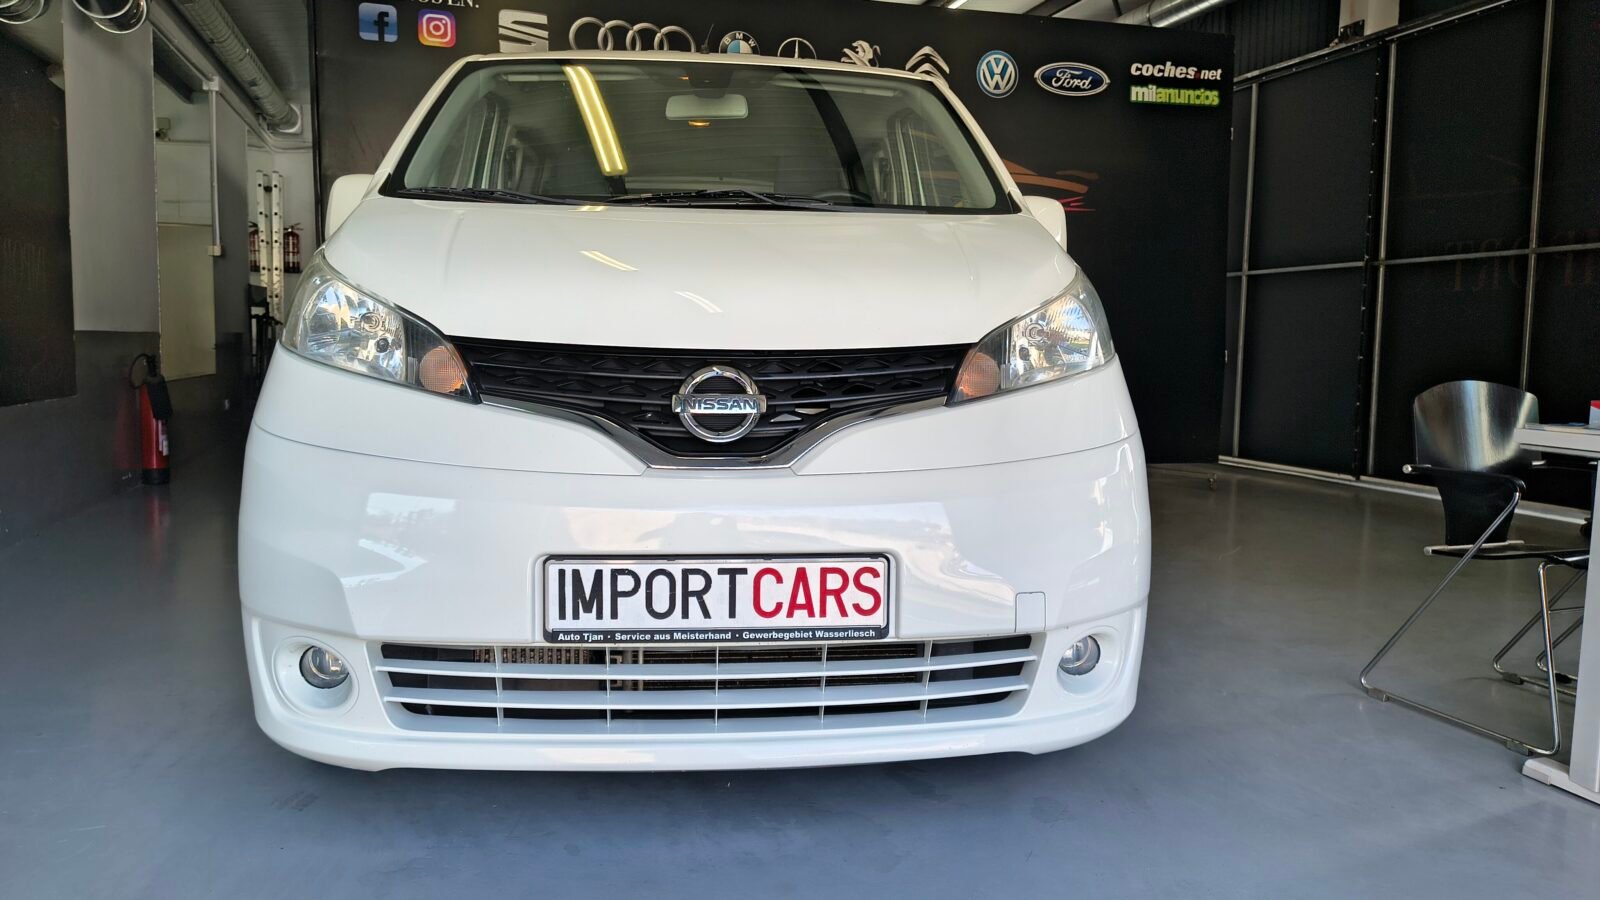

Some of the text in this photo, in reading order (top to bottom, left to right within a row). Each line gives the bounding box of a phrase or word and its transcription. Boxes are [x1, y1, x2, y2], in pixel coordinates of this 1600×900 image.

[1051, 68, 1093, 90] Ford
[1131, 61, 1222, 80] coches.net
[1131, 84, 1219, 105] milanuncios
[683, 397, 758, 411] NISSAN
[558, 632, 580, 641] Auto
[583, 632, 604, 643] Tjan
[615, 632, 651, 641] Service
[673, 631, 732, 640] Meisterhand
[742, 630, 813, 641] Gewerbegebiet
[815, 629, 876, 639] Wasserliesch
